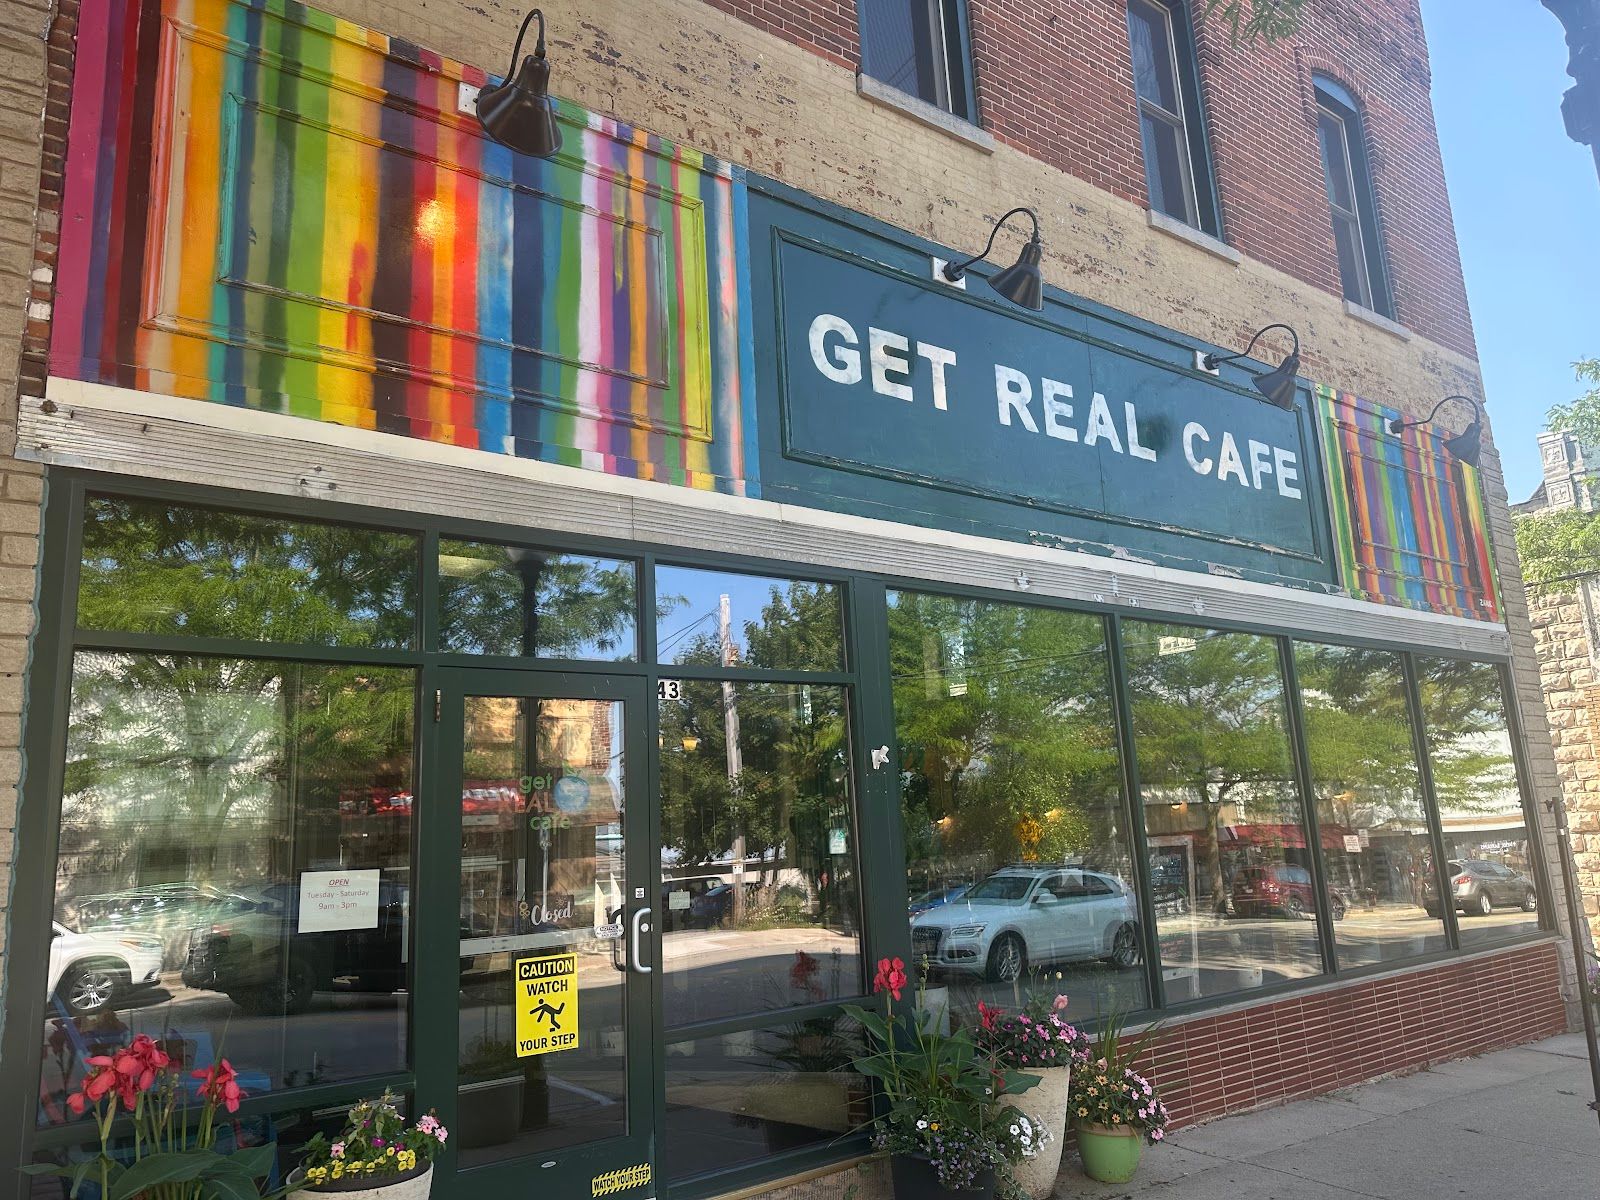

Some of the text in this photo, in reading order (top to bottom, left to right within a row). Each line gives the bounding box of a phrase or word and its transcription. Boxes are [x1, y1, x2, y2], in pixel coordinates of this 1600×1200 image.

[808, 313, 1301, 499] GET REAL CAFE
[657, 681, 678, 698] 43
[520, 773, 552, 793] get
[328, 878, 350, 886] OPEN
[307, 891, 335, 899] Tuesday
[340, 889, 369, 898] Saturday
[318, 902, 335, 910] 9am
[340, 901, 358, 910] 3pm
[531, 901, 574, 926] Closed
[520, 958, 574, 978] CAUTION
[526, 979, 568, 997] WATCH
[519, 1037, 547, 1052] YOUR
[551, 1033, 576, 1047] STEP
[594, 1169, 649, 1190] WATCH YOUR STEP
